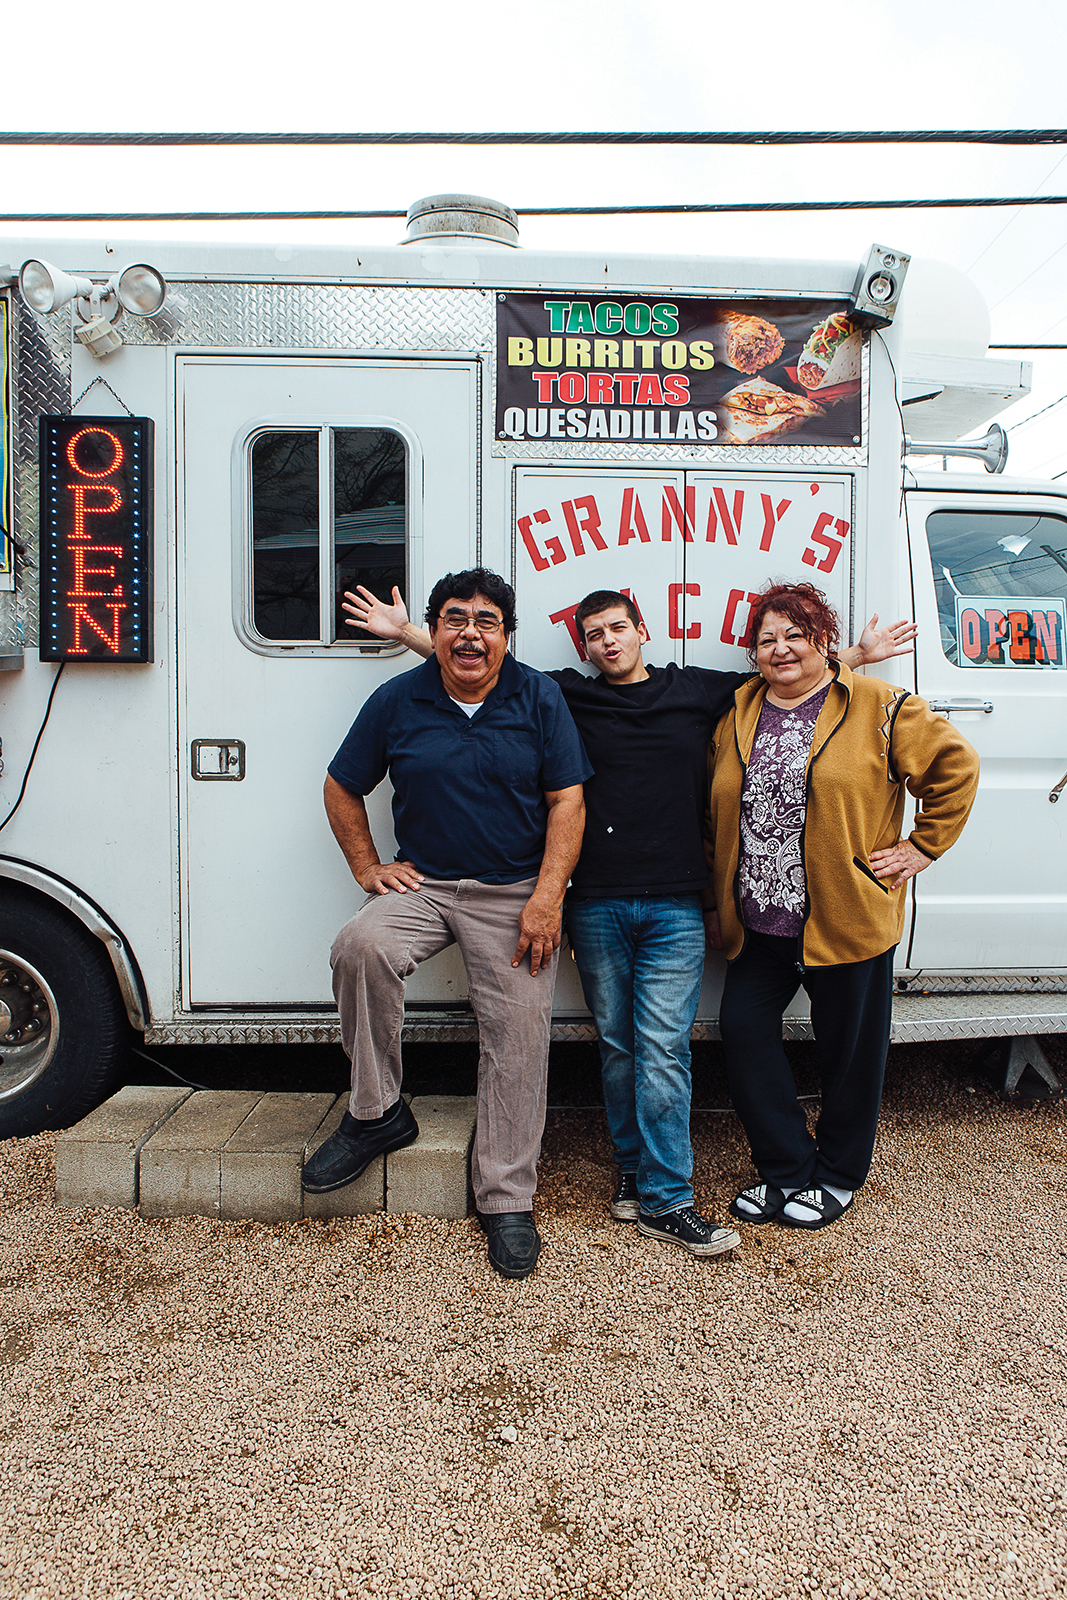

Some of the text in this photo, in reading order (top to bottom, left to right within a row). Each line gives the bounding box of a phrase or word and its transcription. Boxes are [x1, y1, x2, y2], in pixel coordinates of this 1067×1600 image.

[544, 301, 680, 337] TACOS
[507, 336, 715, 371] BURRITOS
[532, 371, 691, 407] TORTAS
[503, 406, 719, 441] QUESADILLAS
[66, 426, 126, 655] OPEN
[517, 483, 850, 574] GRANNY'S
[961, 608, 1062, 665] OPEN
[794, 1194, 825, 1210] adidas
